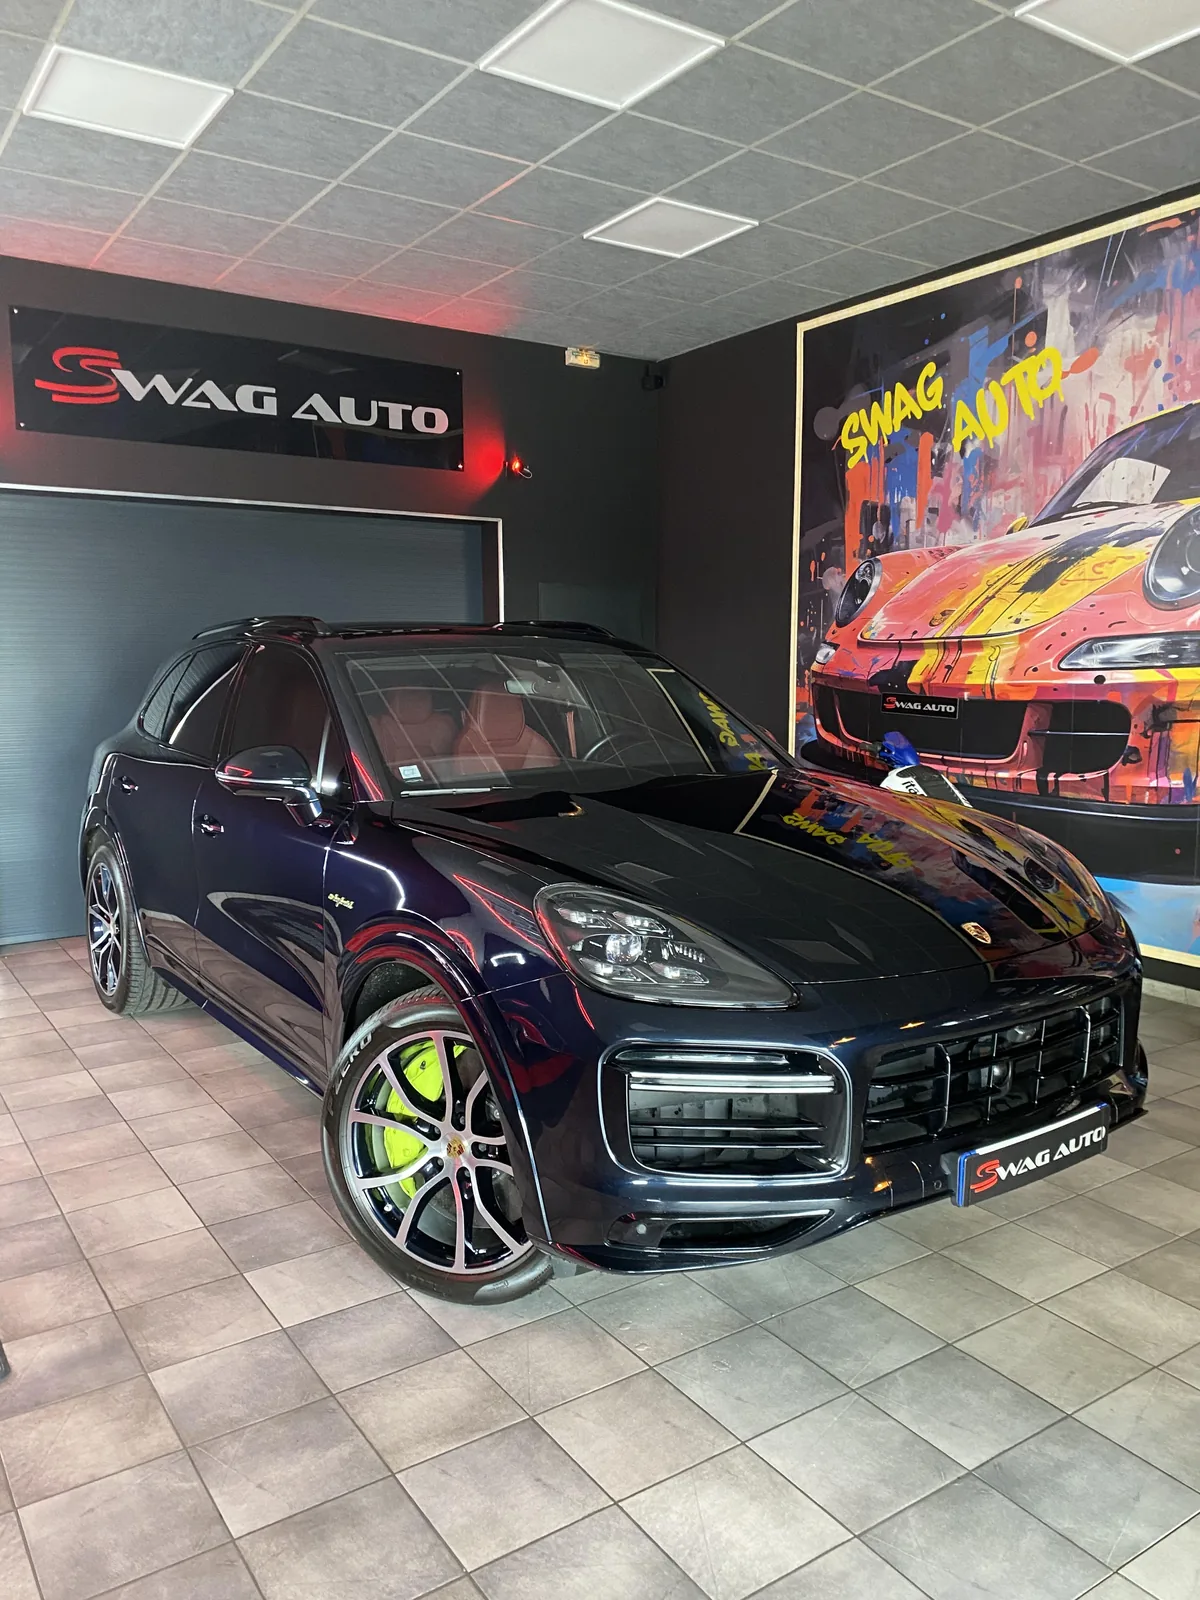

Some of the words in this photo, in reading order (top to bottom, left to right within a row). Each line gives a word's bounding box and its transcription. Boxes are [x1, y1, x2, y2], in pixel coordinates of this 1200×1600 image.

[35, 346, 277, 416] SWAG
[291, 393, 450, 435] AUTO
[841, 361, 944, 469] SWAG
[951, 347, 1064, 453] AUTO
[883, 696, 921, 710] SWAG
[922, 703, 956, 713] AUTO
[969, 1149, 1050, 1194] SWAG
[1053, 1125, 1106, 1161] AUTO
